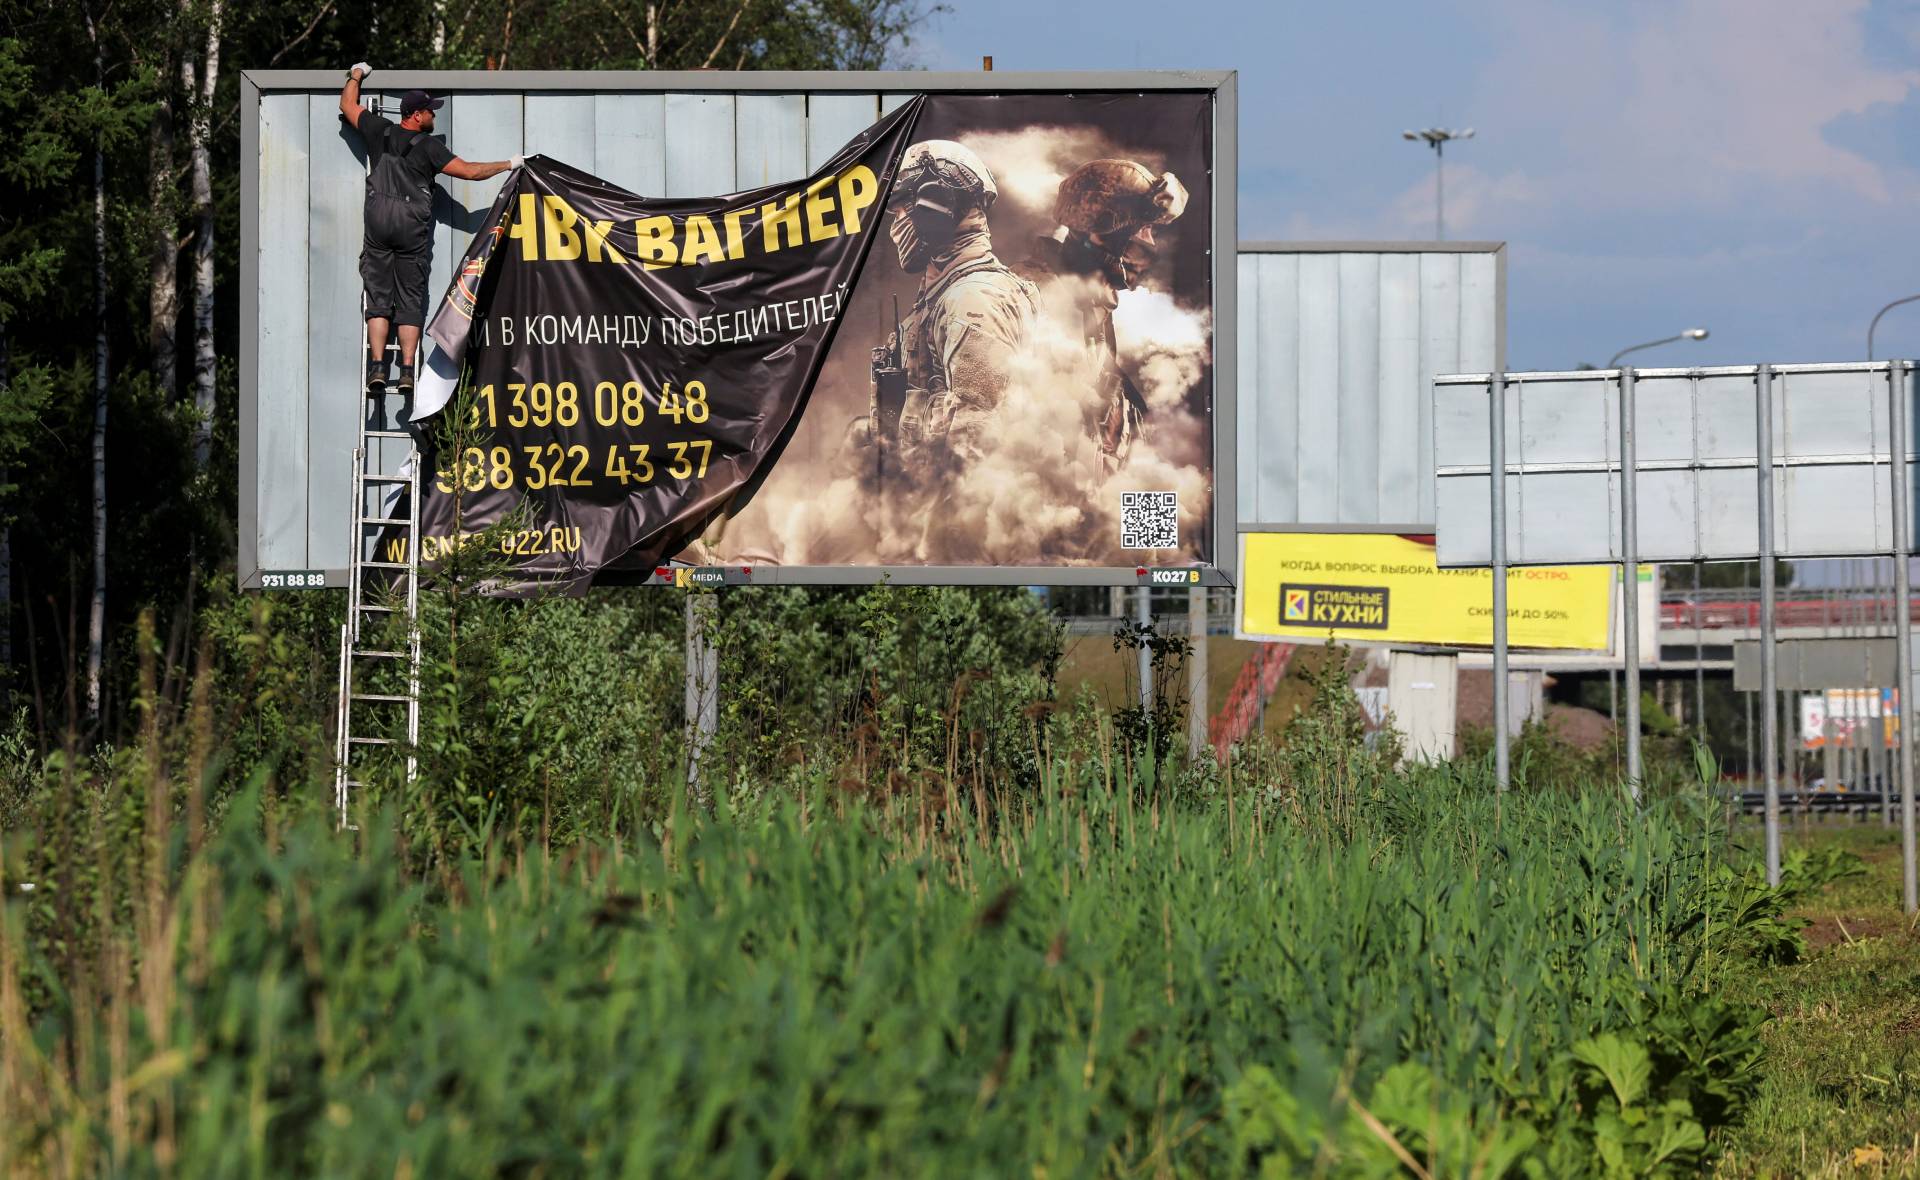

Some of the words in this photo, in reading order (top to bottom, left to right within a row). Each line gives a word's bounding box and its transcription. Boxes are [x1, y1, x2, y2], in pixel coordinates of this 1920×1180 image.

[635, 165, 879, 271] ВАГНЕР
[501, 316, 515, 346] В
[525, 314, 651, 349] КОМАНДУ
[507, 382, 579, 428] 398
[595, 381, 645, 427] 08
[658, 380, 710, 425] 48
[523, 442, 593, 489] 322
[605, 444, 654, 486] 43
[667, 440, 713, 481] 37
[1281, 560, 1321, 571] КОГДА
[1325, 562, 1377, 574] ВОПРОС
[1381, 565, 1434, 575] ВЫБОРА
[261, 574, 284, 587] 931
[287, 574, 305, 587] 88
[307, 574, 325, 586] 88
[692, 574, 723, 582] MEDIA
[1313, 590, 1384, 606] СТИЛЬНЫЕ
[1313, 604, 1383, 624] КУХНИ
[1522, 609, 1541, 620] ДО
